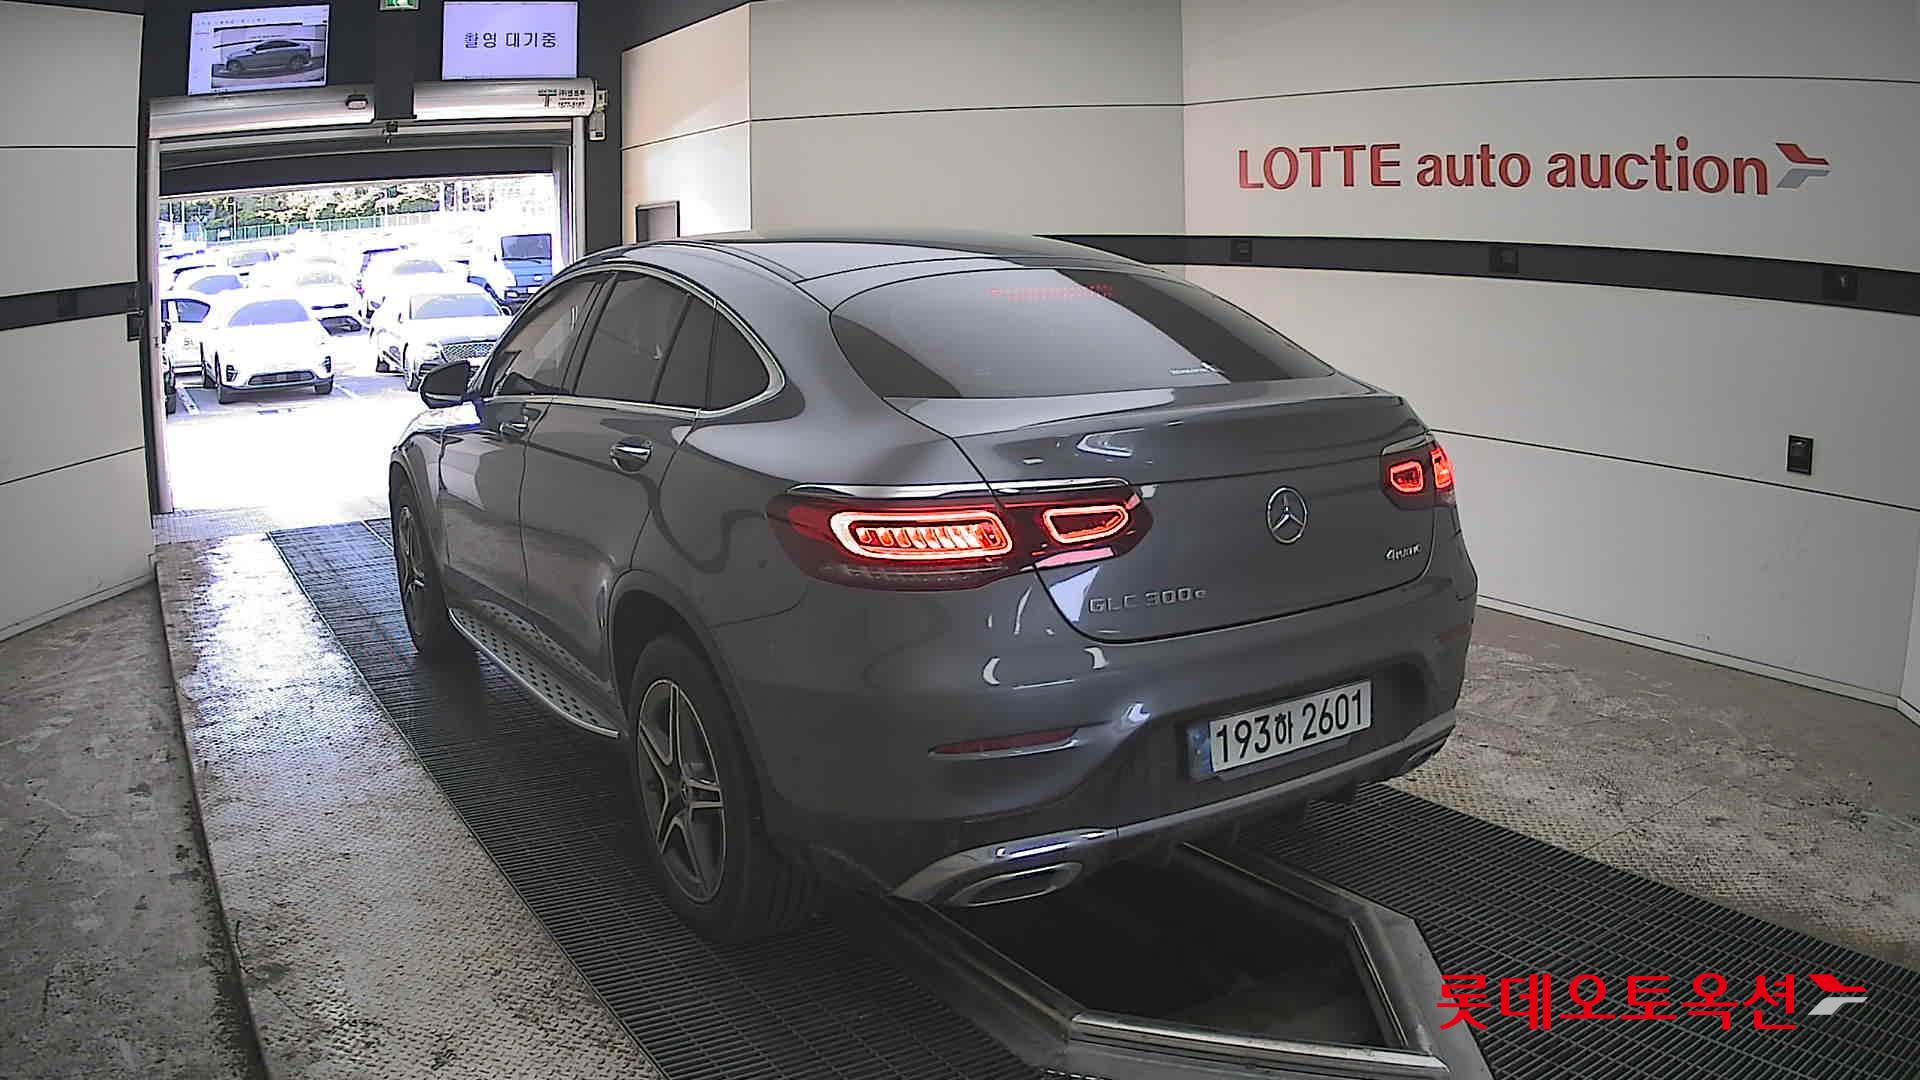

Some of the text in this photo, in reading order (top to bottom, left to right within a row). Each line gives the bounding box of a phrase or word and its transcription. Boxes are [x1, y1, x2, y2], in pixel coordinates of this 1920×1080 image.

[464, 31, 557, 49] 촬영 대기중
[1238, 135, 1769, 196] LOTTE auto auction
[1088, 594, 1138, 614] GLC
[1215, 688, 1362, 764] 193하 2601
